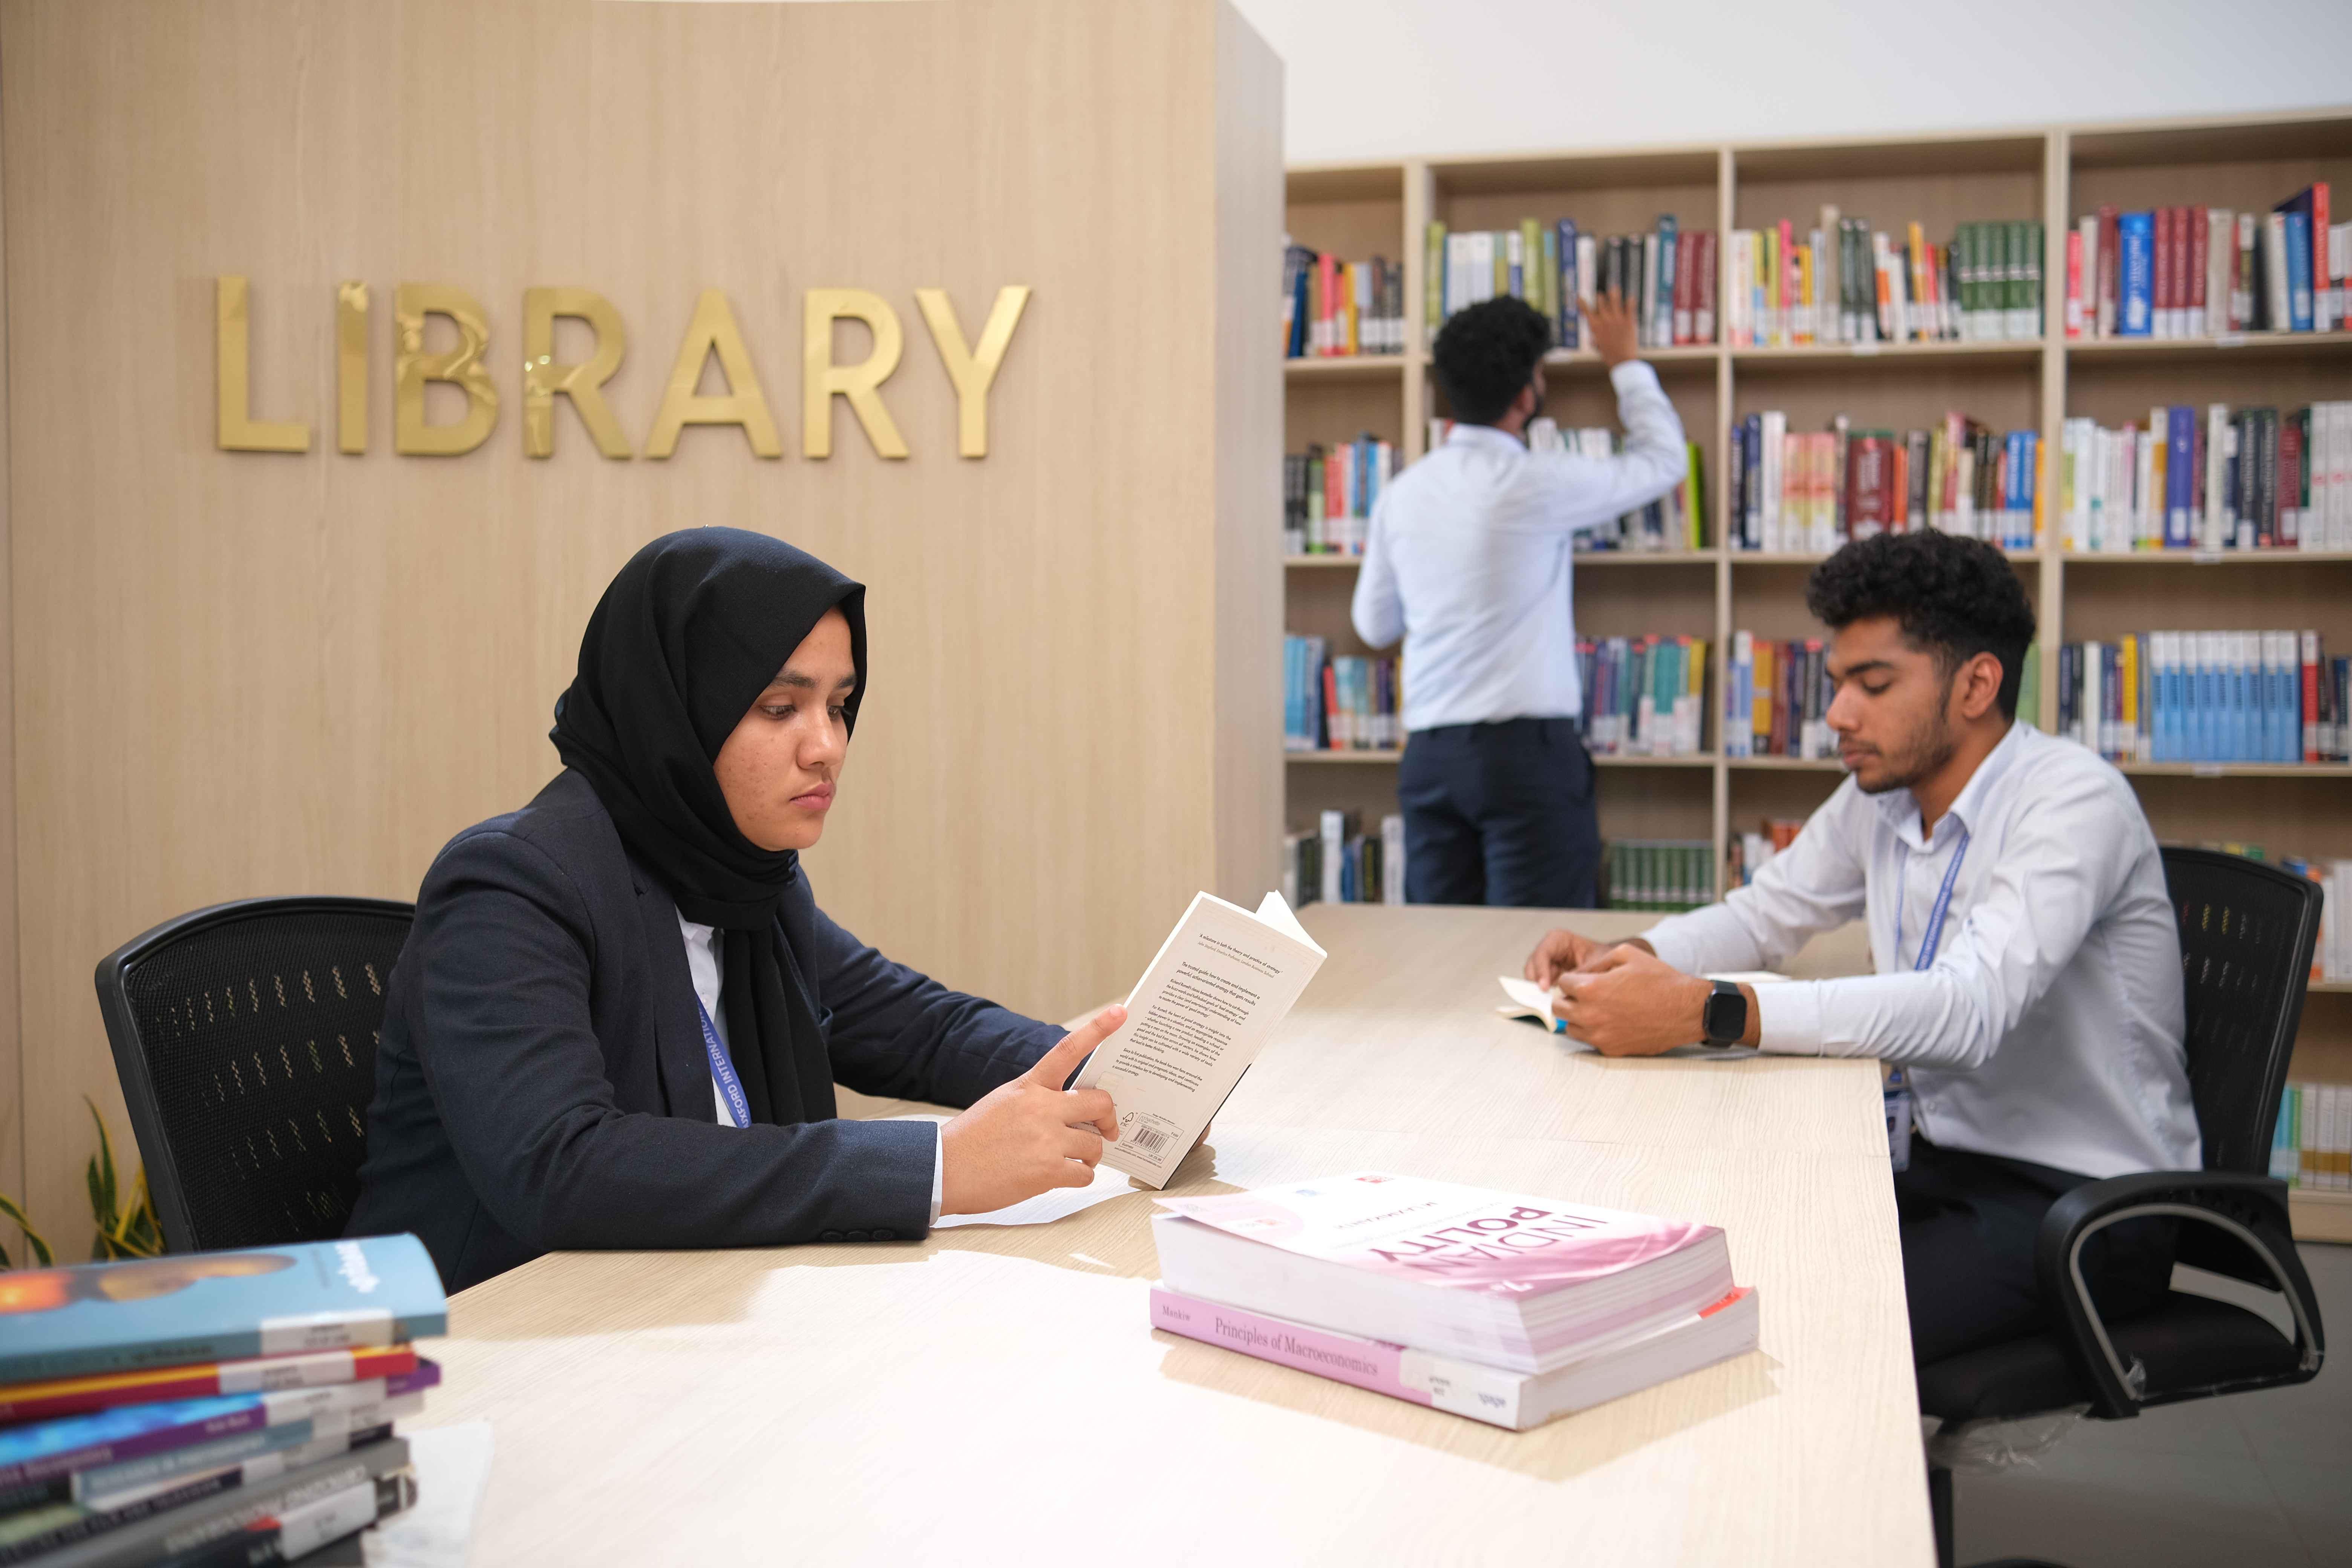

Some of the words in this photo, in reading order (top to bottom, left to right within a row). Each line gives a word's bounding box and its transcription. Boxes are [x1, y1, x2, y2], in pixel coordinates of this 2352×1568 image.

[214, 275, 1032, 460] LIBRARY
[1192, 975, 1217, 987] action-oriented
[1215, 985, 1230, 994] strategy
[1238, 986, 1257, 998] implement
[1209, 1009, 1231, 1021] understanding
[1236, 1007, 1249, 1015] through
[1159, 1020, 1173, 1030] launching
[1193, 1035, 1206, 1043] heading
[1195, 1029, 1213, 1039] appropriate
[1213, 1037, 1228, 1046] response
[1178, 1035, 1191, 1044] Drawing
[1195, 1043, 1210, 1052] examples
[1145, 1116, 1160, 1125] hachette
[1369, 1206, 1554, 1263] POLITY
[1402, 1215, 1609, 1275] INDIAN
[1162, 1305, 1191, 1321] Mankiw
[1214, 1316, 1269, 1348] Principles
[1271, 1335, 1284, 1351] of
[1284, 1336, 1379, 1377] Macroeconomics
